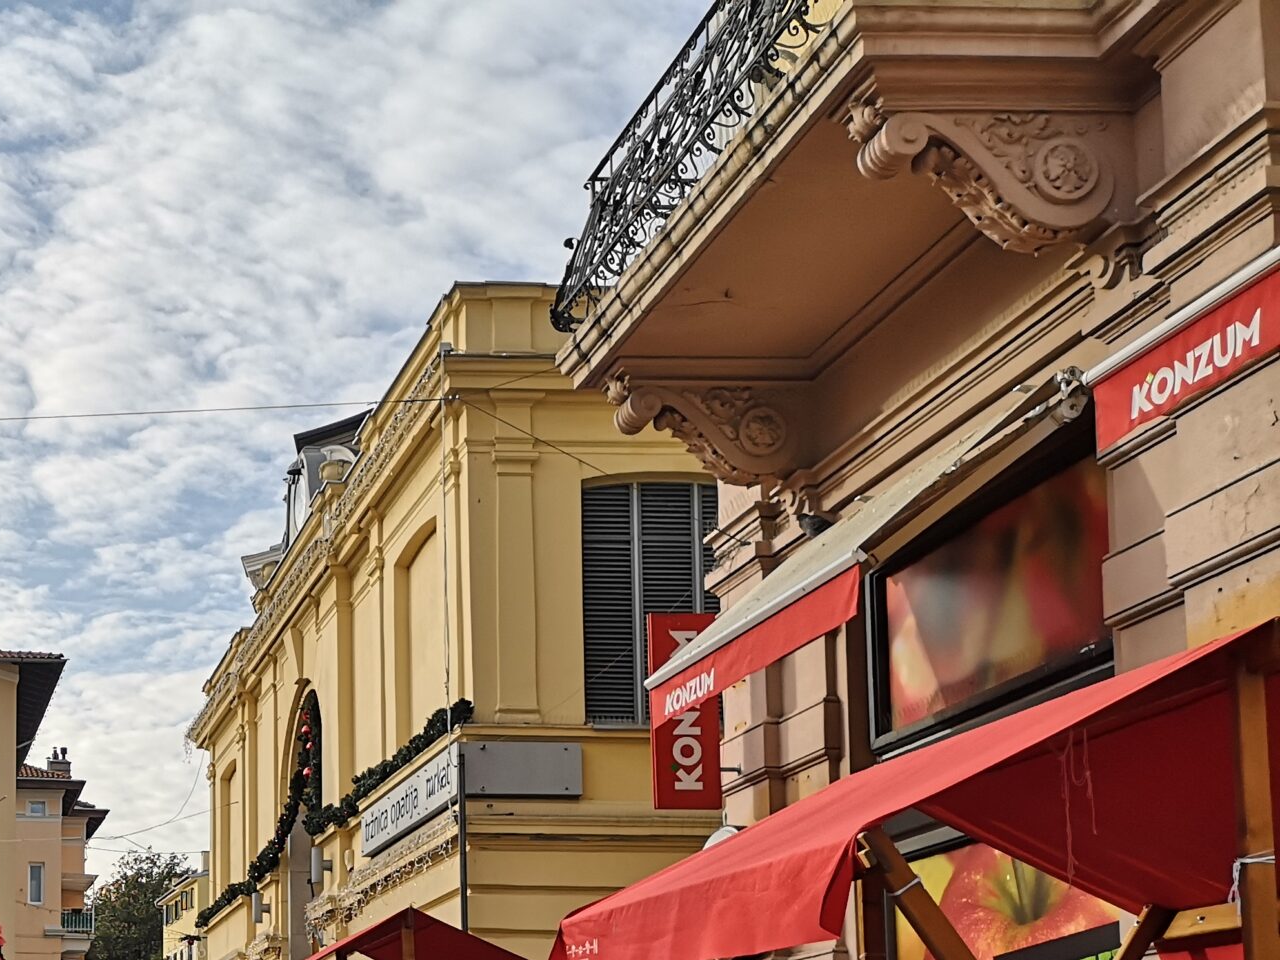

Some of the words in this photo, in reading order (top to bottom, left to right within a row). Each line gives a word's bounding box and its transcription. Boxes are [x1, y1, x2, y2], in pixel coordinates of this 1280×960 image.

[1131, 307, 1261, 420] KONZUM
[664, 668, 715, 716] KONZUM
[391, 784, 418, 829] opatija
